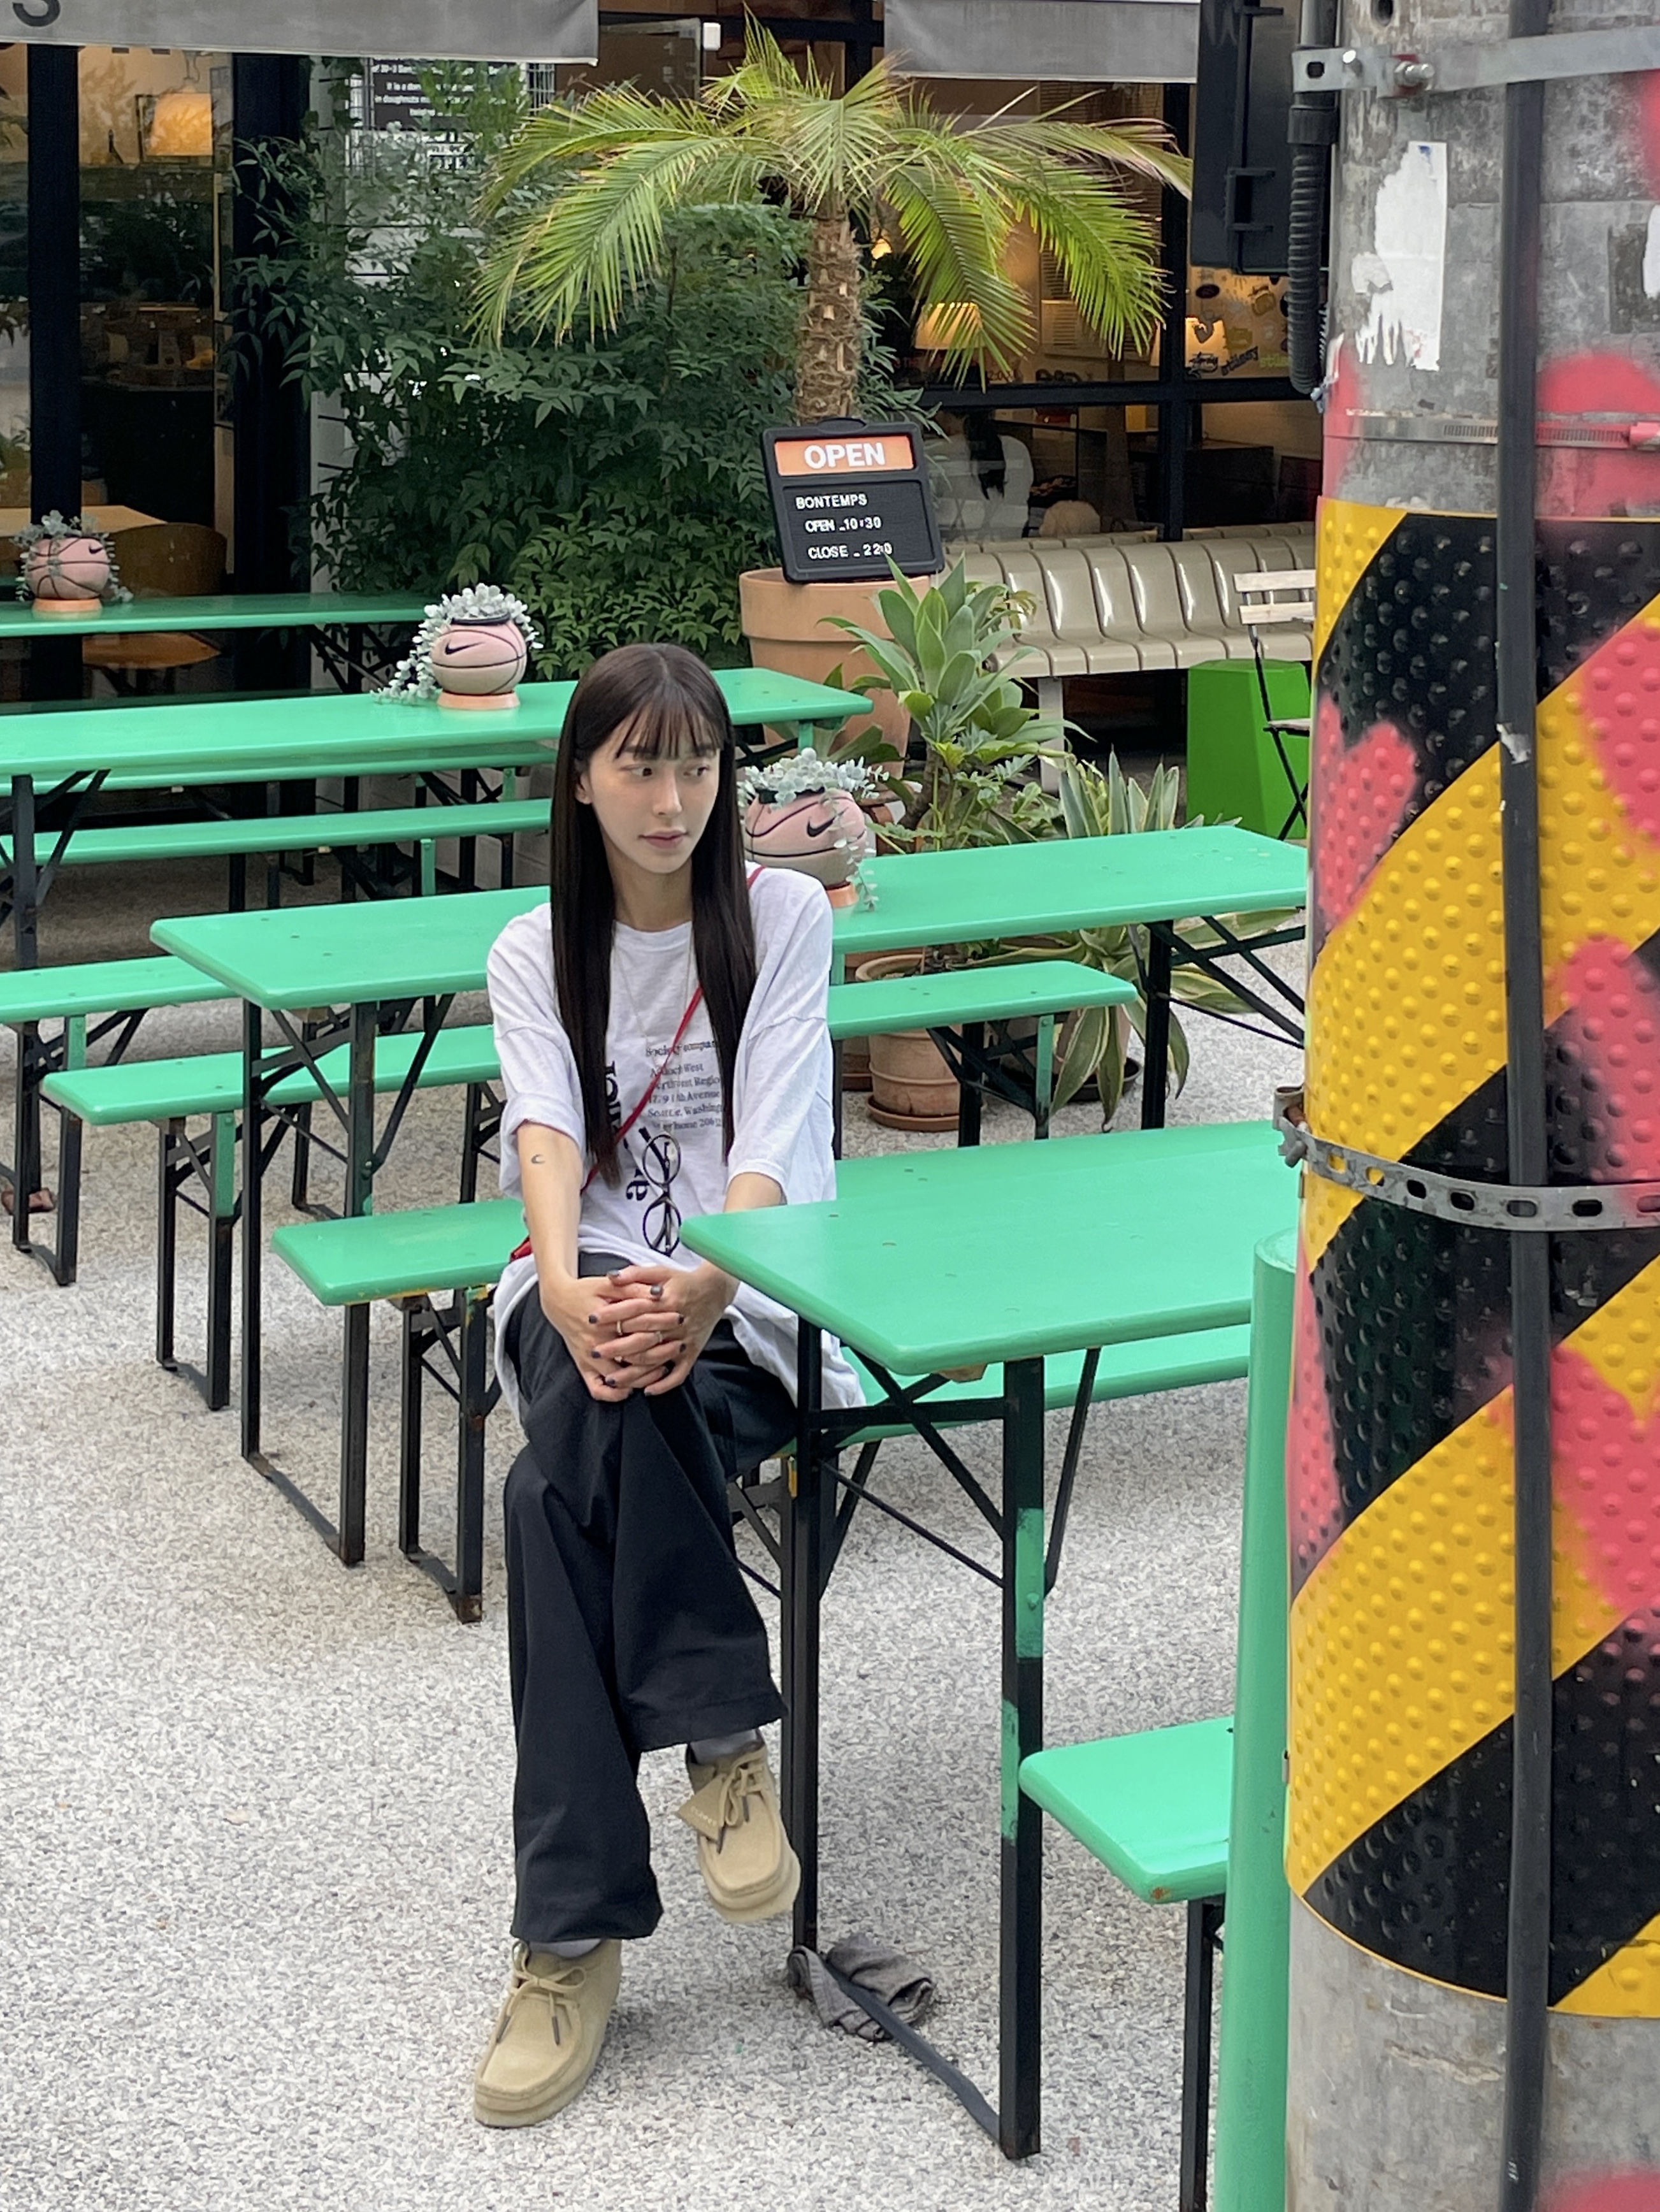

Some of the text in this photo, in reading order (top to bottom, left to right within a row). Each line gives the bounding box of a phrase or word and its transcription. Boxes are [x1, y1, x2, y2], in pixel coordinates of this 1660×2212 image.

[804, 442, 886, 469] OPEN
[796, 493, 867, 510] BONTEMPS
[805, 519, 835, 533] OPEN
[808, 545, 848, 560] CLOSE
